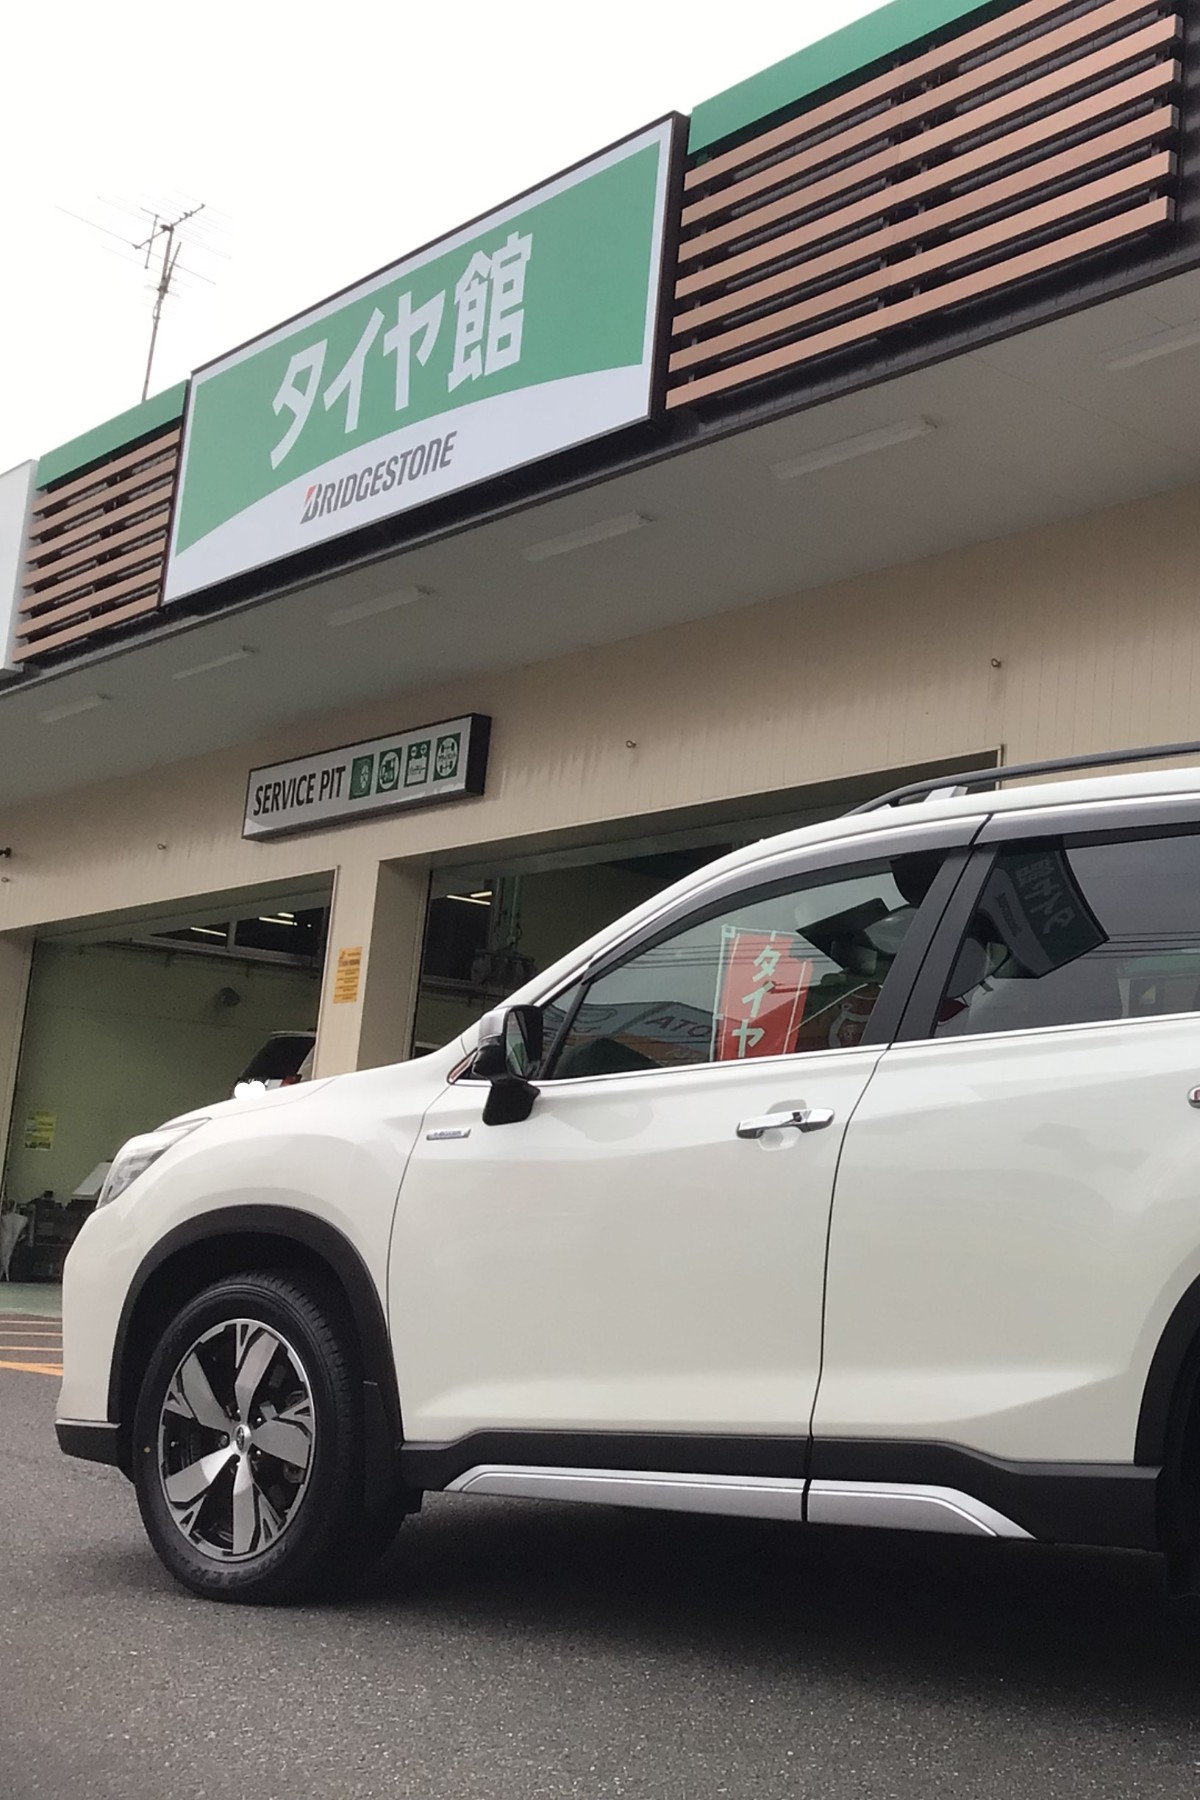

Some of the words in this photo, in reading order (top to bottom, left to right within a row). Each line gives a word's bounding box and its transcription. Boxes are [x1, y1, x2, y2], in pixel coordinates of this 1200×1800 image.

[269, 231, 533, 471] タイヤ館
[300, 431, 458, 525] BRIDGESTONE
[253, 773, 316, 816] SERVICE
[318, 765, 346, 802] PIT
[731, 945, 782, 1058] タイヤ
